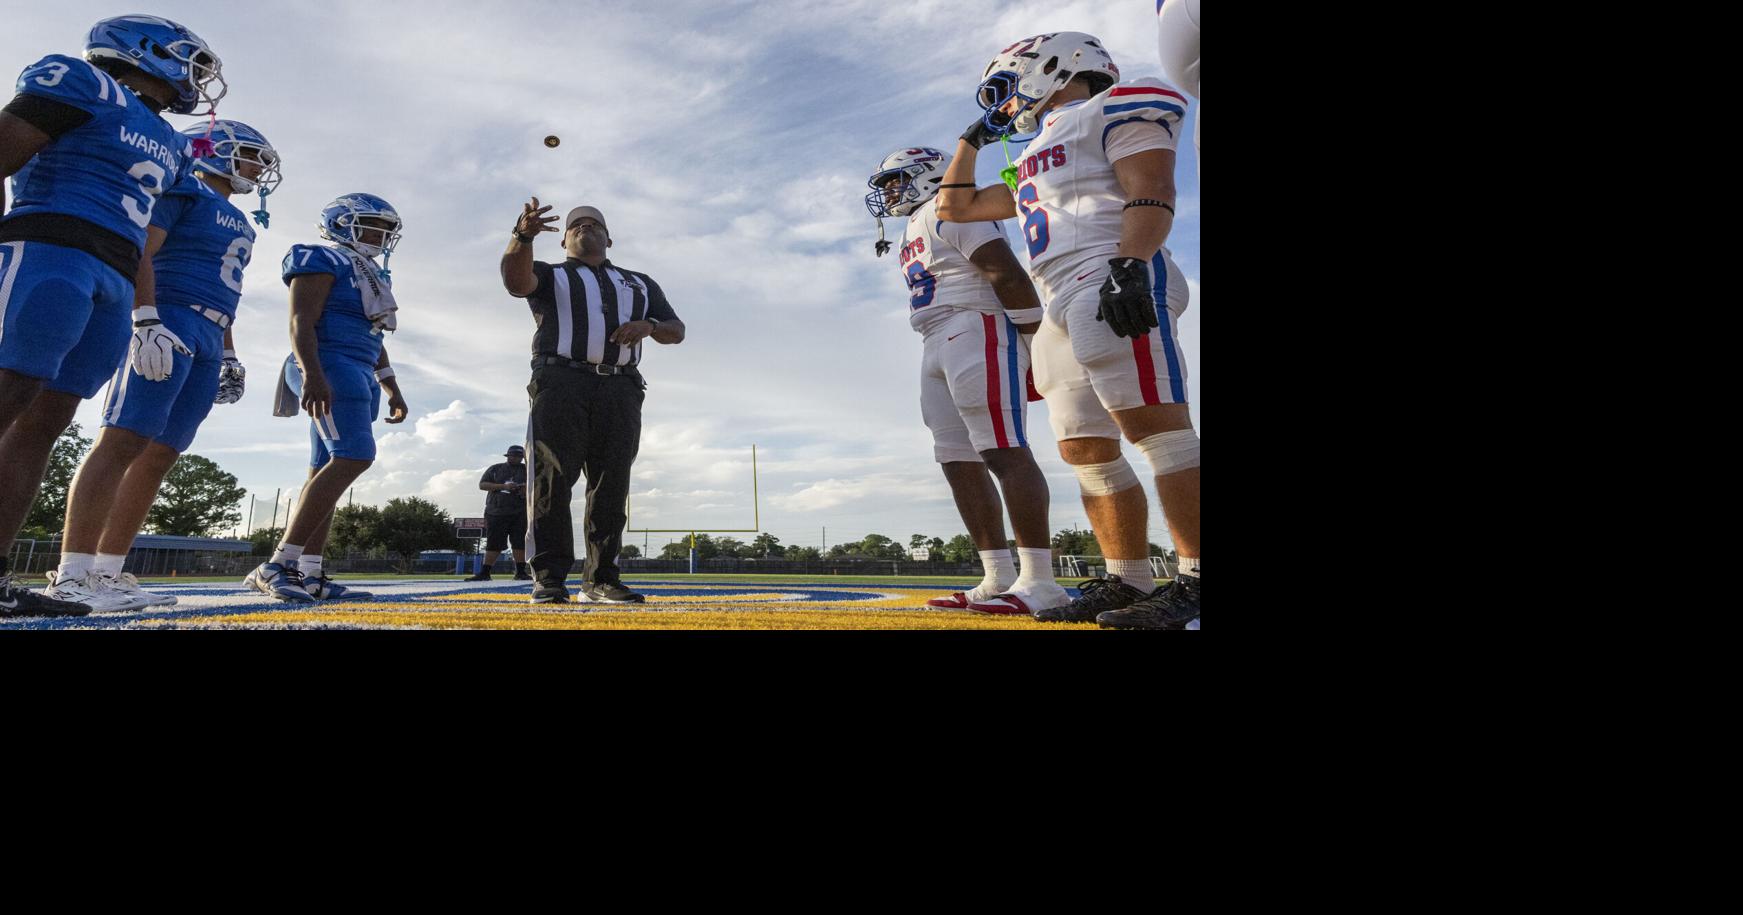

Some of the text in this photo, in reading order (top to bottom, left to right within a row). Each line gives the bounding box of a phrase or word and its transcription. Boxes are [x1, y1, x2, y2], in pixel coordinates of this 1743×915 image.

[35, 62, 70, 87] 3
[121, 160, 166, 228] 3
[1018, 182, 1051, 260] 6
[220, 237, 253, 293] 8
[299, 249, 313, 266] 7
